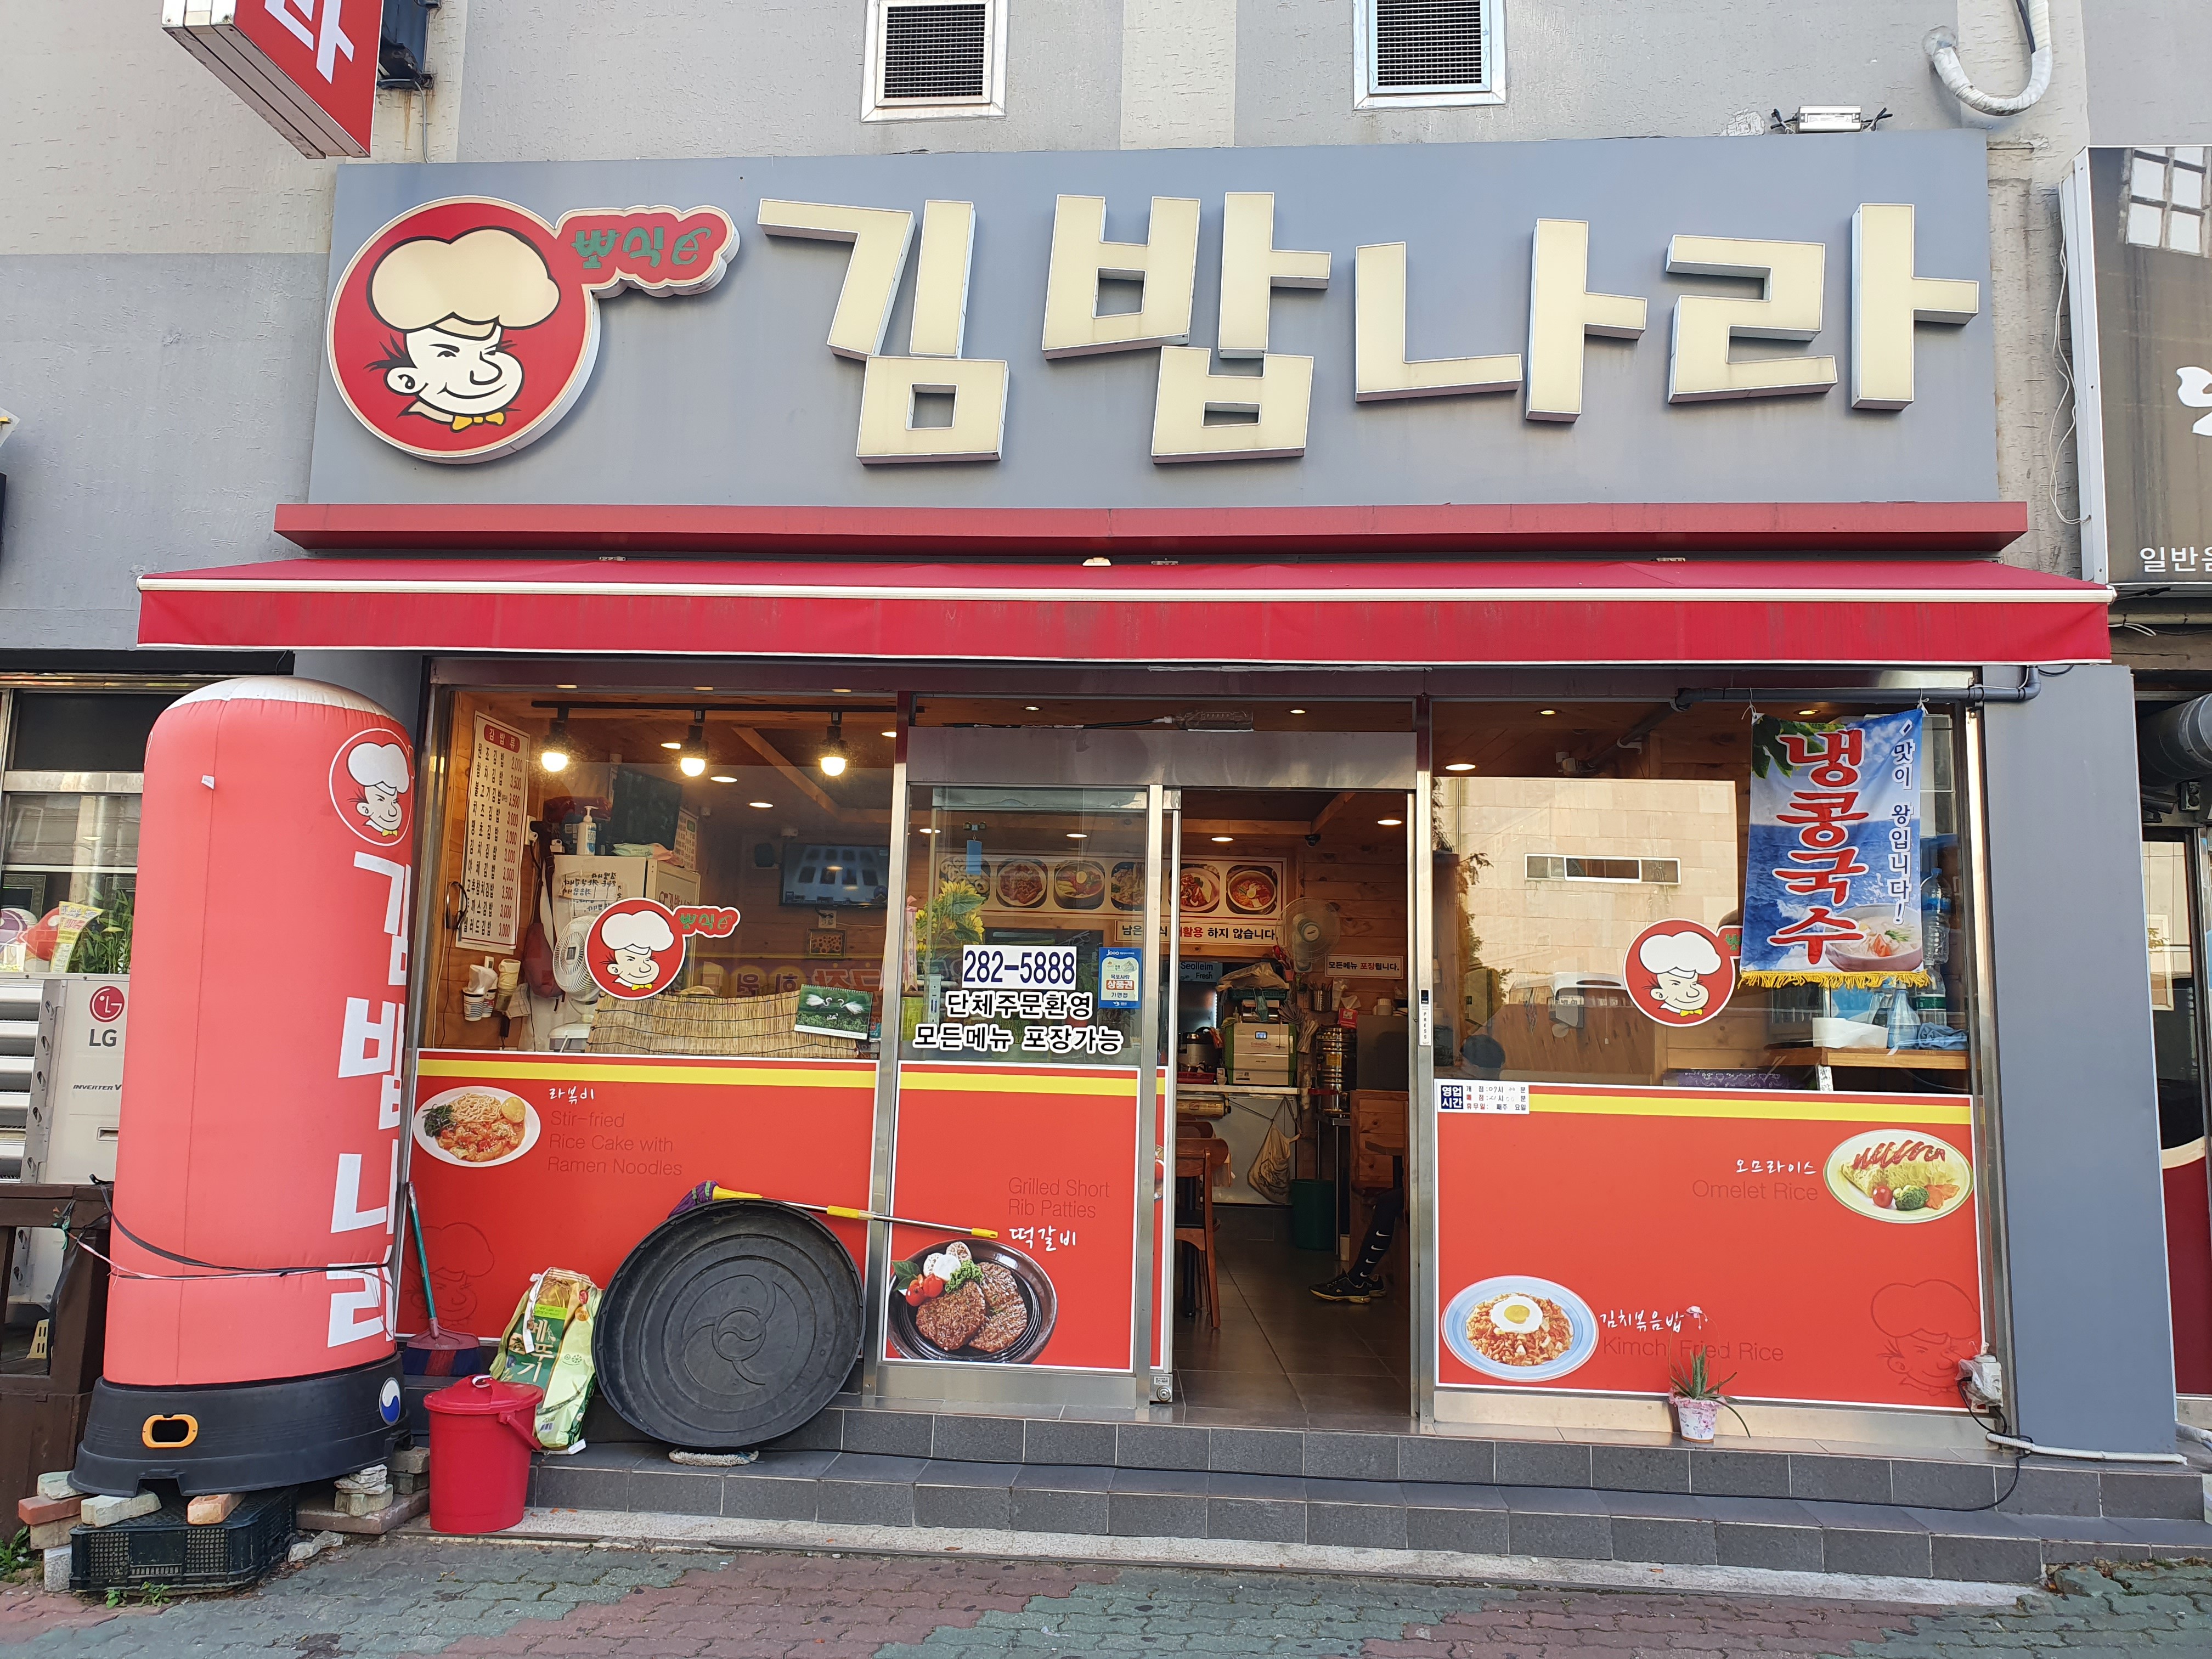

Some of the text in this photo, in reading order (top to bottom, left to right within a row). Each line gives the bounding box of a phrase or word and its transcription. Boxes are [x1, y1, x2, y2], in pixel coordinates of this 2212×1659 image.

[758, 192, 1979, 464] 김밥나라
[489, 728, 515, 750] 김밥류
[1768, 730, 1869, 964] 냉콩국수
[1889, 803, 1913, 925] 왕입니다!
[1122, 925, 1143, 936] 남은
[1180, 927, 1203, 938] 활용
[1207, 928, 1228, 939] 하지
[963, 950, 1075, 984] 282-5888
[1107, 980, 1133, 989] 상품권
[947, 993, 1091, 1018] 단체주문환영
[89, 1029, 117, 1047] LG
[915, 1026, 1122, 1052] 모든메뉴 포장가능
[549, 1086, 595, 1105] 라볶이
[1442, 1086, 1462, 1097] 영업
[1442, 1098, 1463, 1108] 시간
[551, 1111, 625, 1128] Stir-fried
[550, 1134, 673, 1153] Rice Cake with
[549, 1157, 682, 1176] Ramen Noodles
[1009, 1176, 1109, 1198] Grilled Short
[1692, 1180, 1818, 1201] Omelet Rice
[1009, 1199, 1096, 1218] Rib Patties
[1009, 1224, 1076, 1251] 떡갈비
[1600, 1309, 1684, 1333] 김치볶음밥
[1604, 1337, 1670, 1357] Kimch
[1739, 1342, 1784, 1361] Rice
